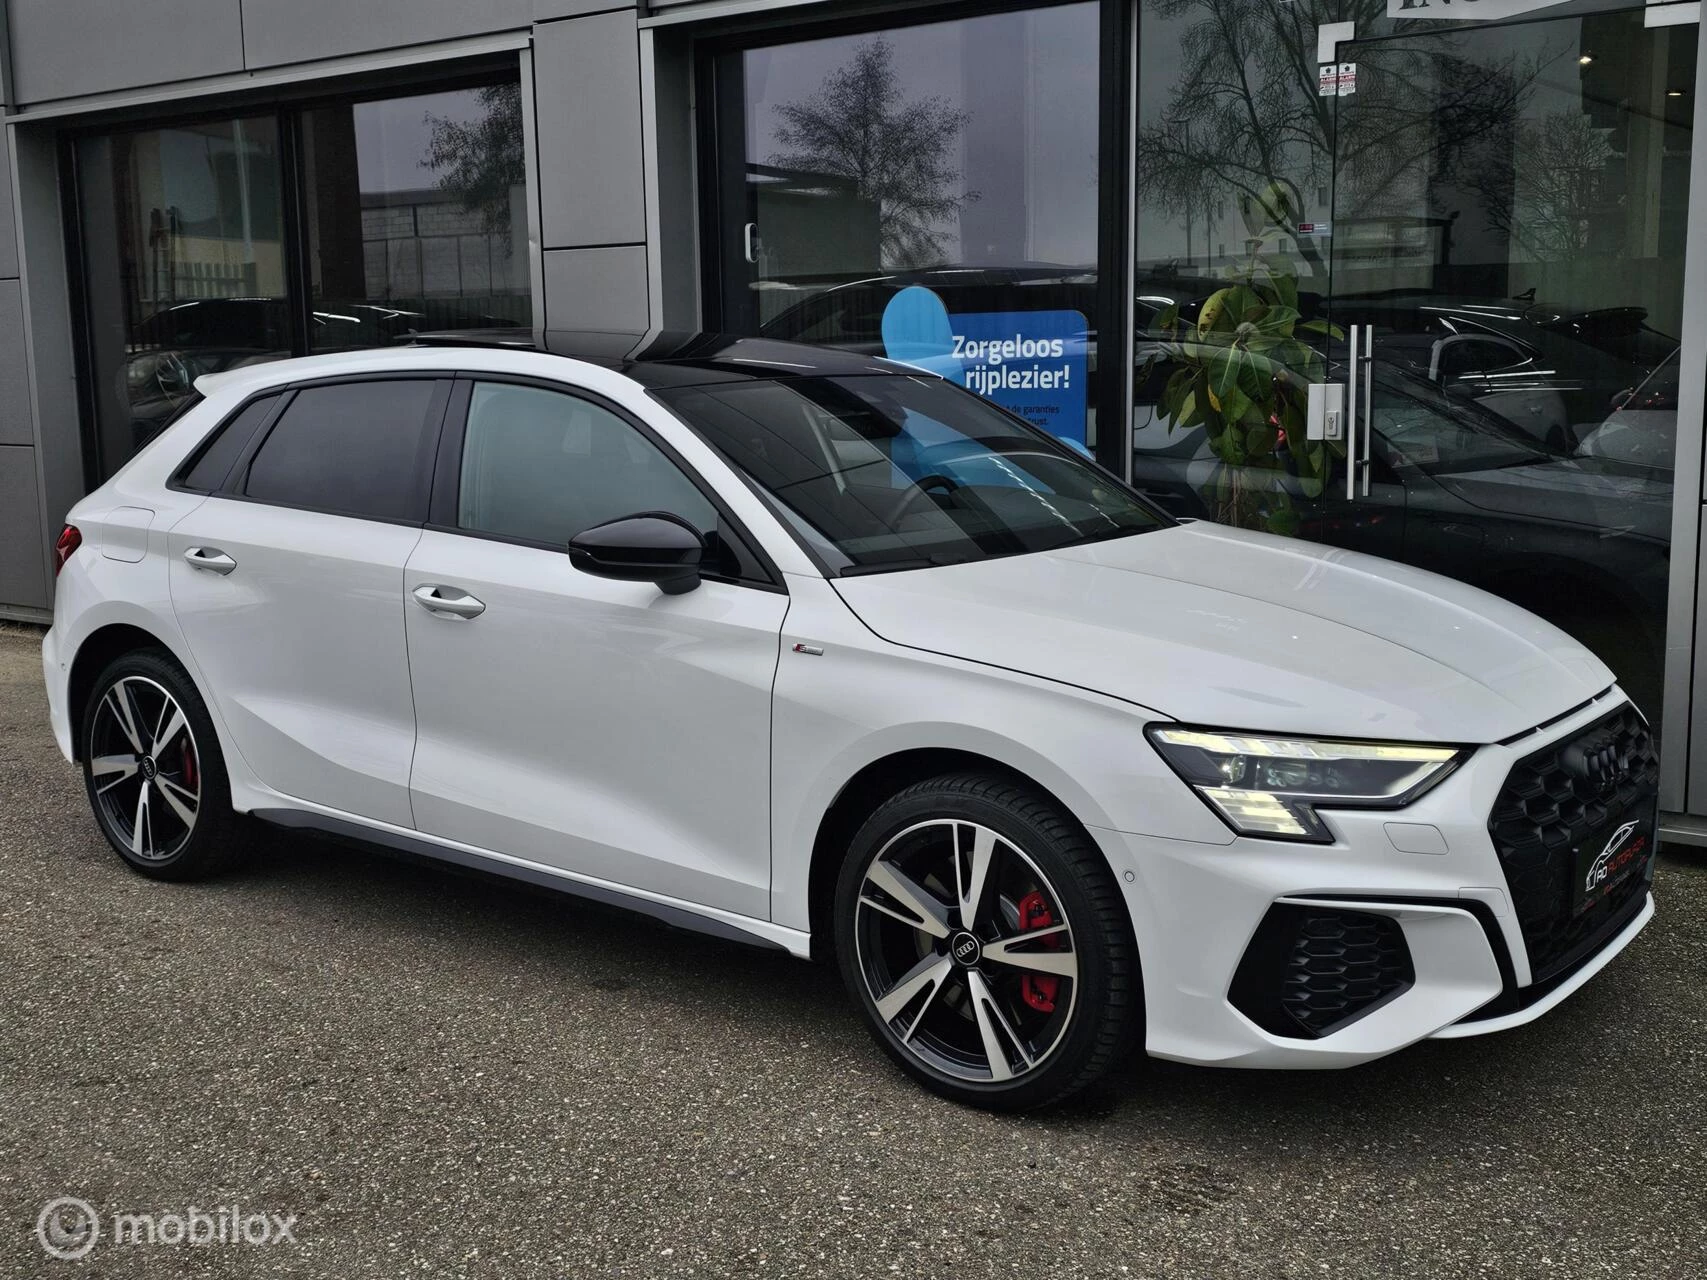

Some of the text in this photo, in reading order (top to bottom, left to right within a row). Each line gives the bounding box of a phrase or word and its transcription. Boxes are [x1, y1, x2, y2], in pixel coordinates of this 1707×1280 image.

[952, 334, 1064, 365] Zorgeloos
[966, 364, 1070, 395] rijplezier!
[1023, 404, 1060, 416] garanties
